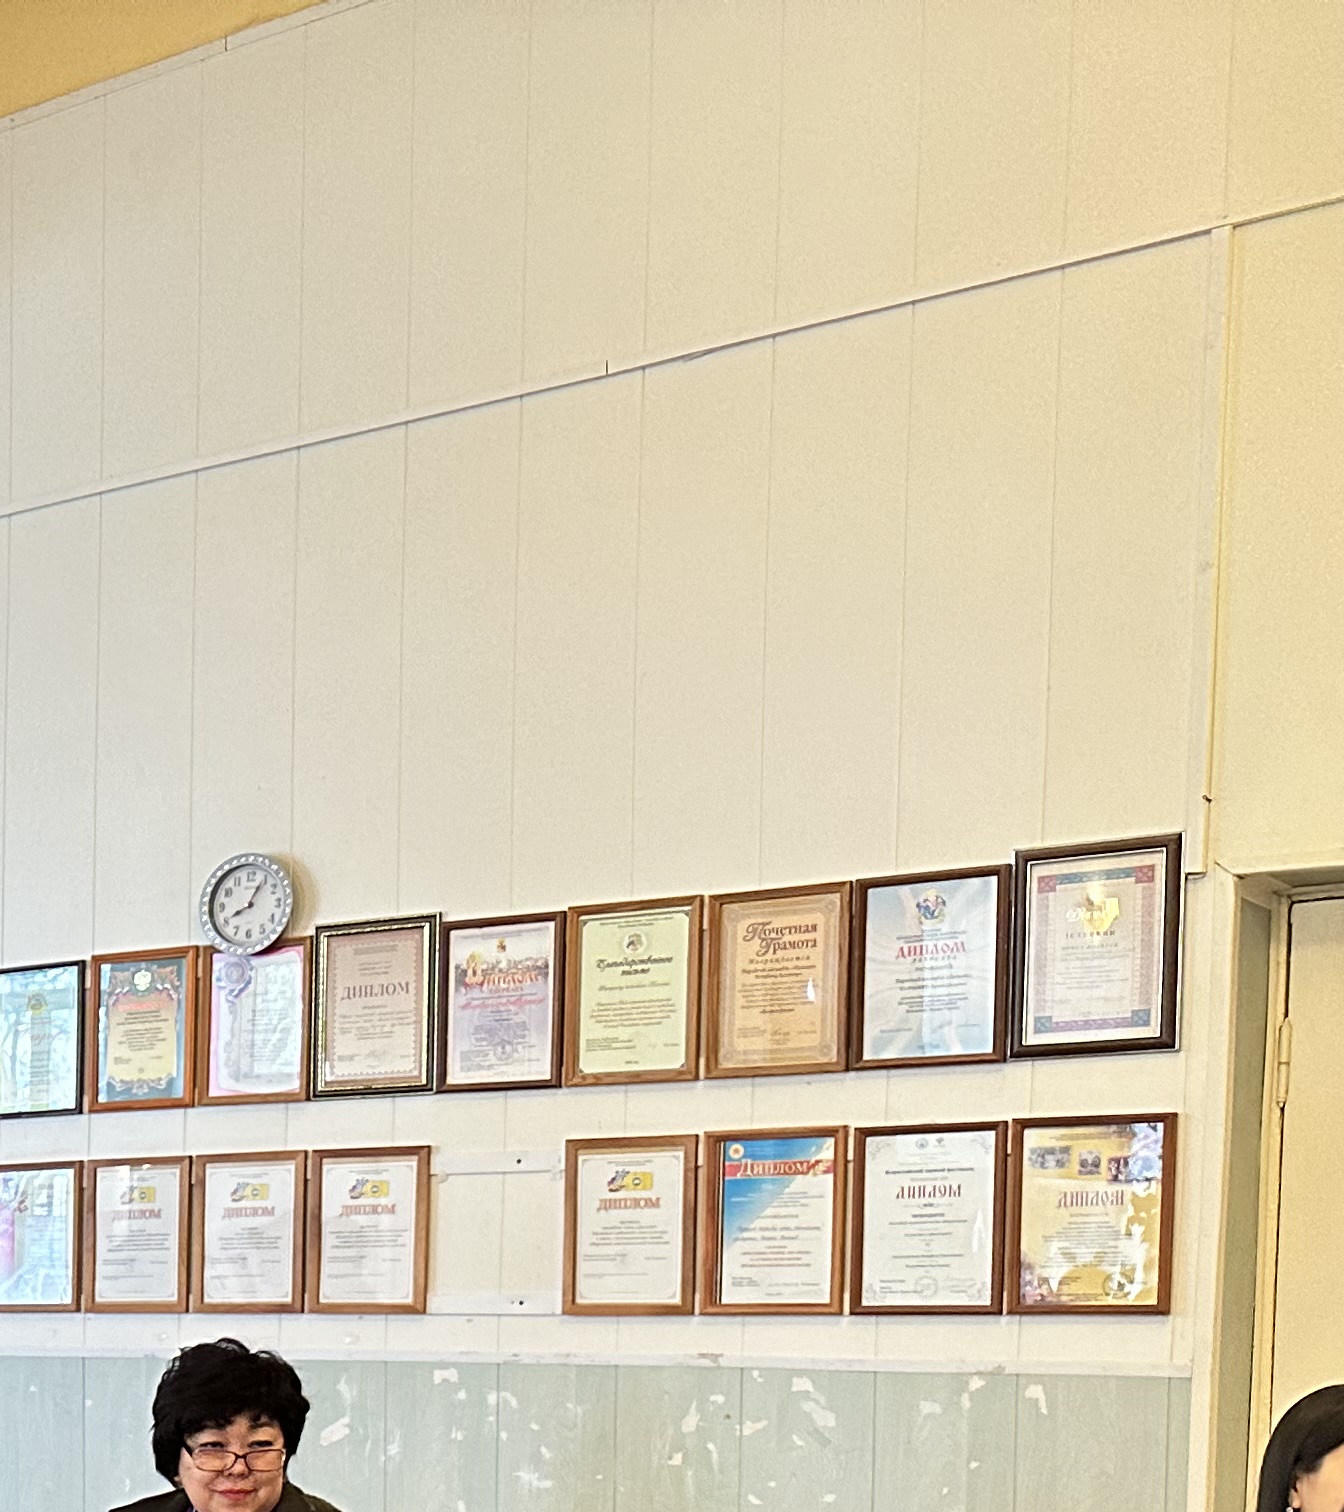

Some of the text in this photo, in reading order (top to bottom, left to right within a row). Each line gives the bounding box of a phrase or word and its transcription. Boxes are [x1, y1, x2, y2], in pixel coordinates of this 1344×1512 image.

[246, 871, 257, 882] 12
[233, 925, 240, 936] 7
[245, 928, 252, 939] 6
[756, 938, 818, 957] Грамота
[895, 941, 966, 960] ДИПЛОМ
[340, 981, 410, 1001] ДИПЛОМ
[896, 1184, 961, 1199] ДИПЛОМ
[1057, 1189, 1124, 1208] ДИПЛОМ
[339, 1204, 396, 1217] ДИПЛОМ
[597, 1197, 661, 1212] ДИПЛОМ
